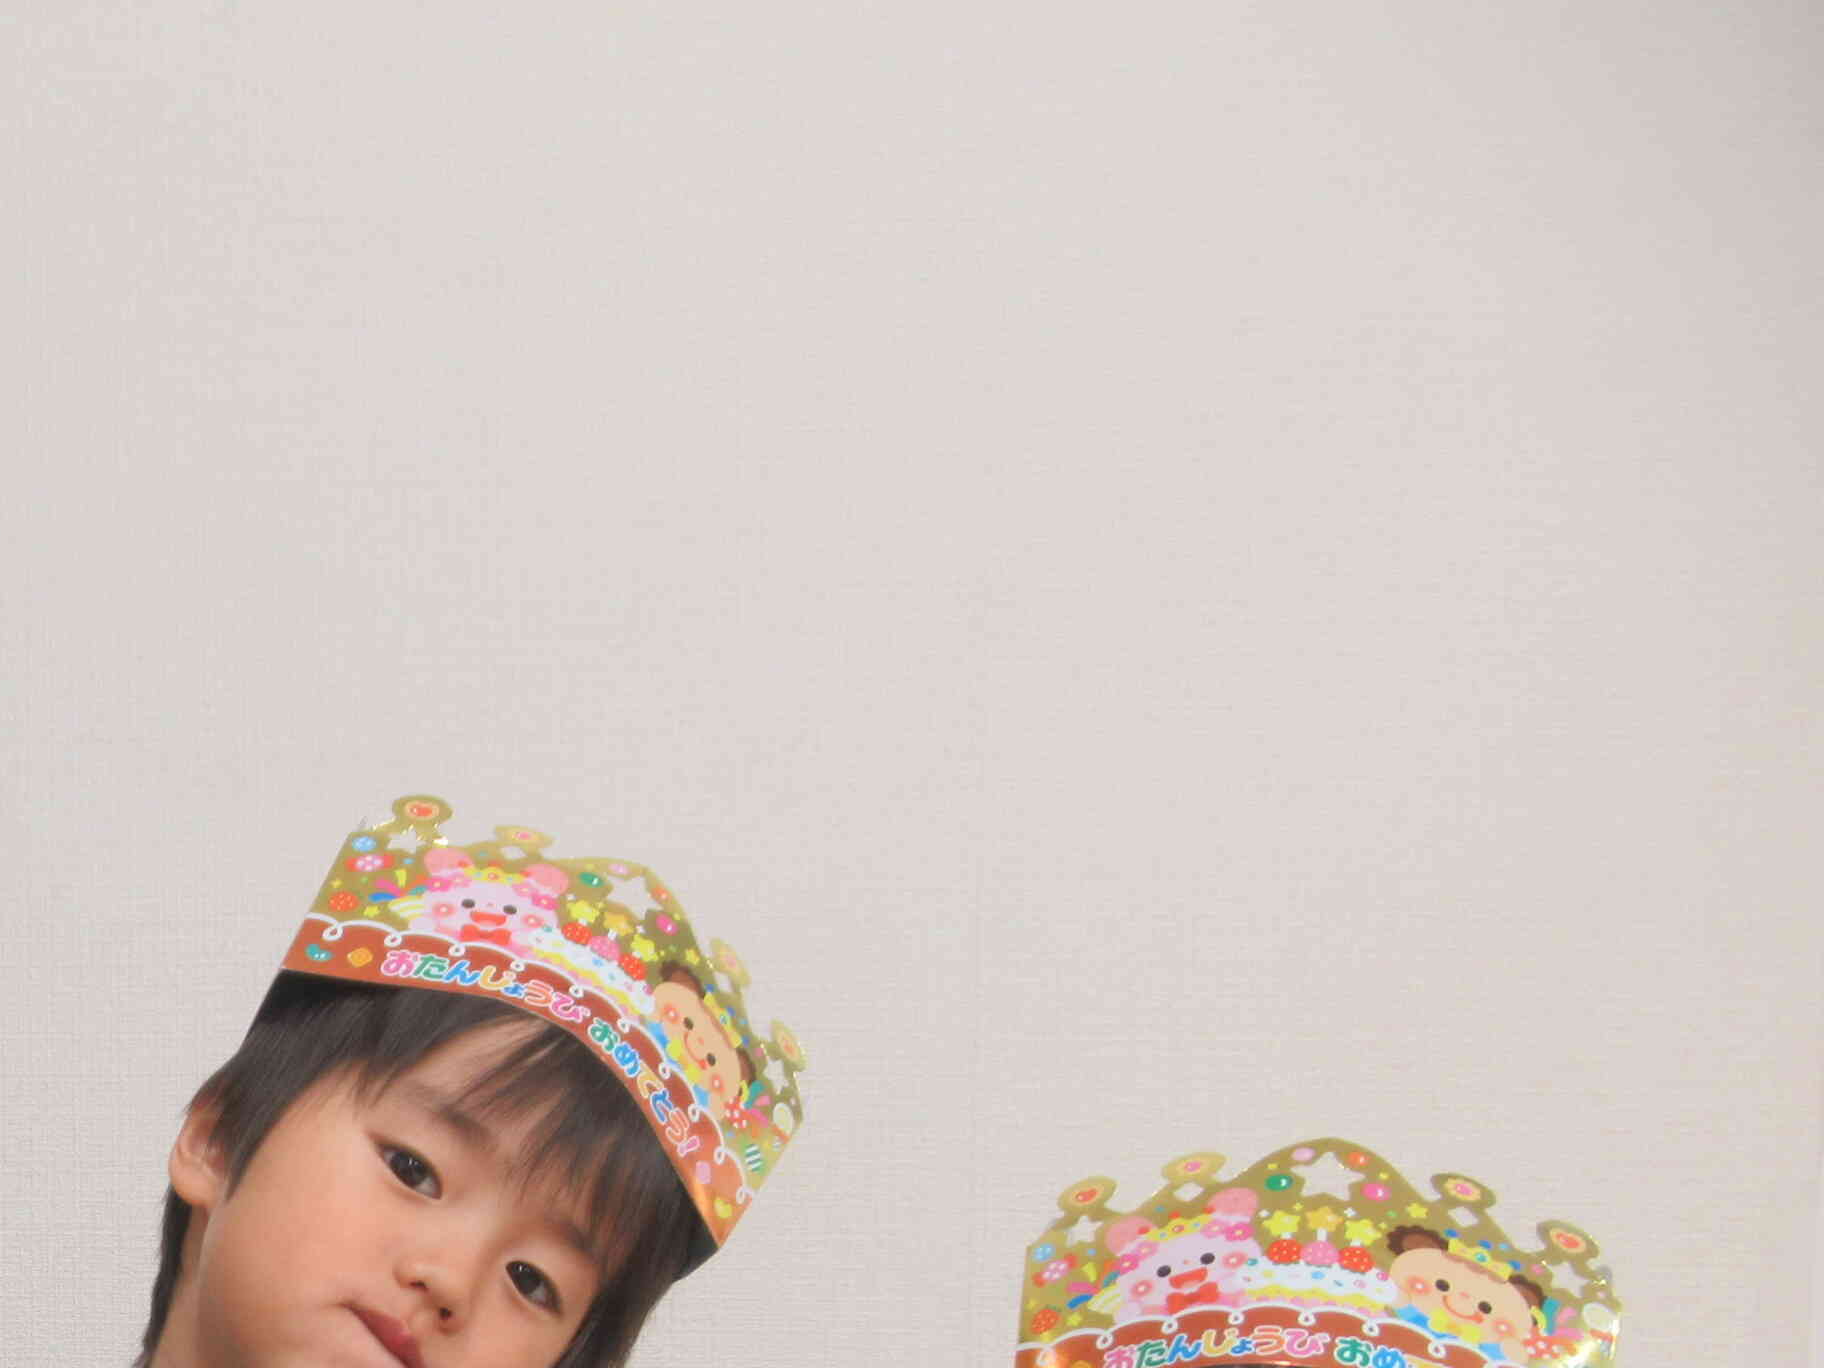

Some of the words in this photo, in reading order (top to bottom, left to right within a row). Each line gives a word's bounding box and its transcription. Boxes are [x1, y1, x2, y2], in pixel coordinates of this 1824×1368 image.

[381, 950, 590, 1023] おたんじょうび
